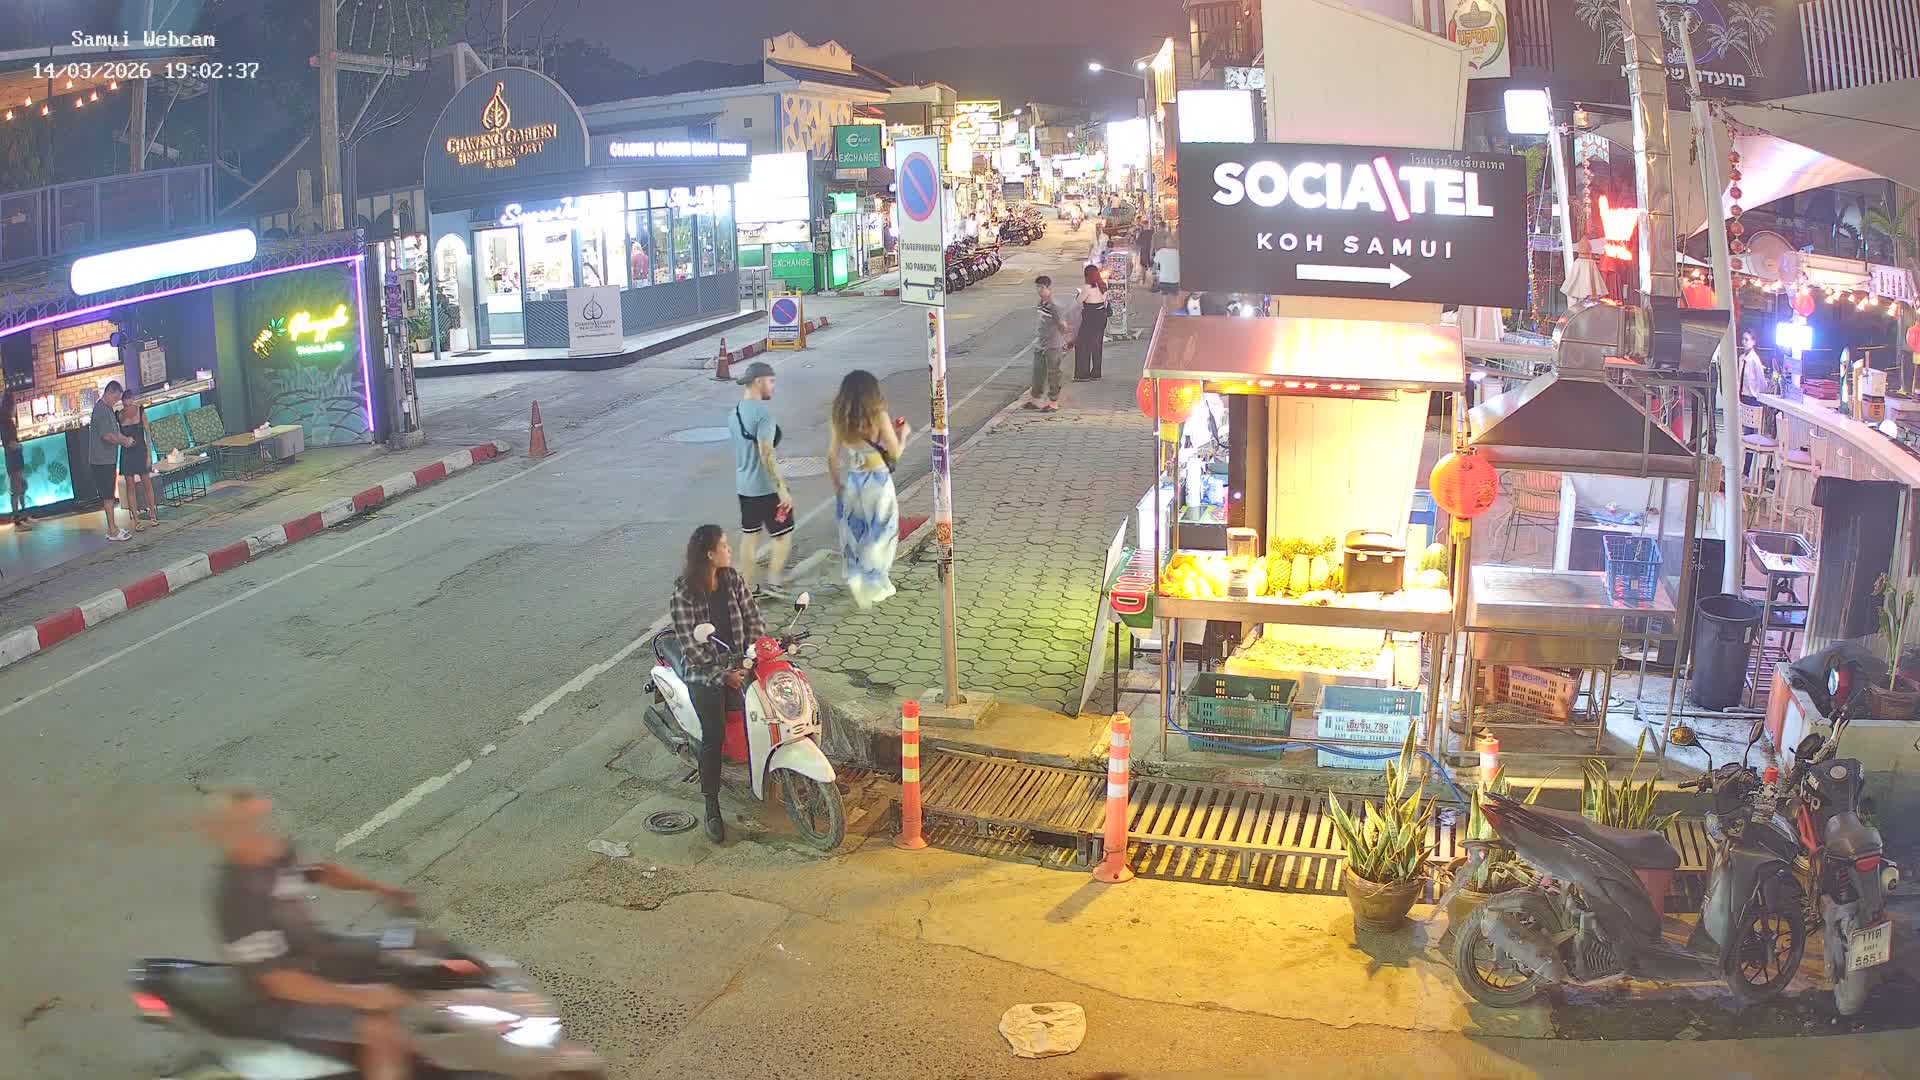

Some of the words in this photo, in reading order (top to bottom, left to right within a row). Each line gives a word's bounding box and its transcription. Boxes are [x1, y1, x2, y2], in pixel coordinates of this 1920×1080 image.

[505, 124, 557, 144] GARDEN
[839, 152, 879, 163] EXCHANGE
[1256, 231, 1323, 252] KOH
[1344, 235, 1452, 259] SAMUI
[772, 257, 811, 268] EXCHANGE
[905, 262, 913, 271] NO
[914, 263, 937, 273] PARKING
[1374, 722, 1389, 731] 789
